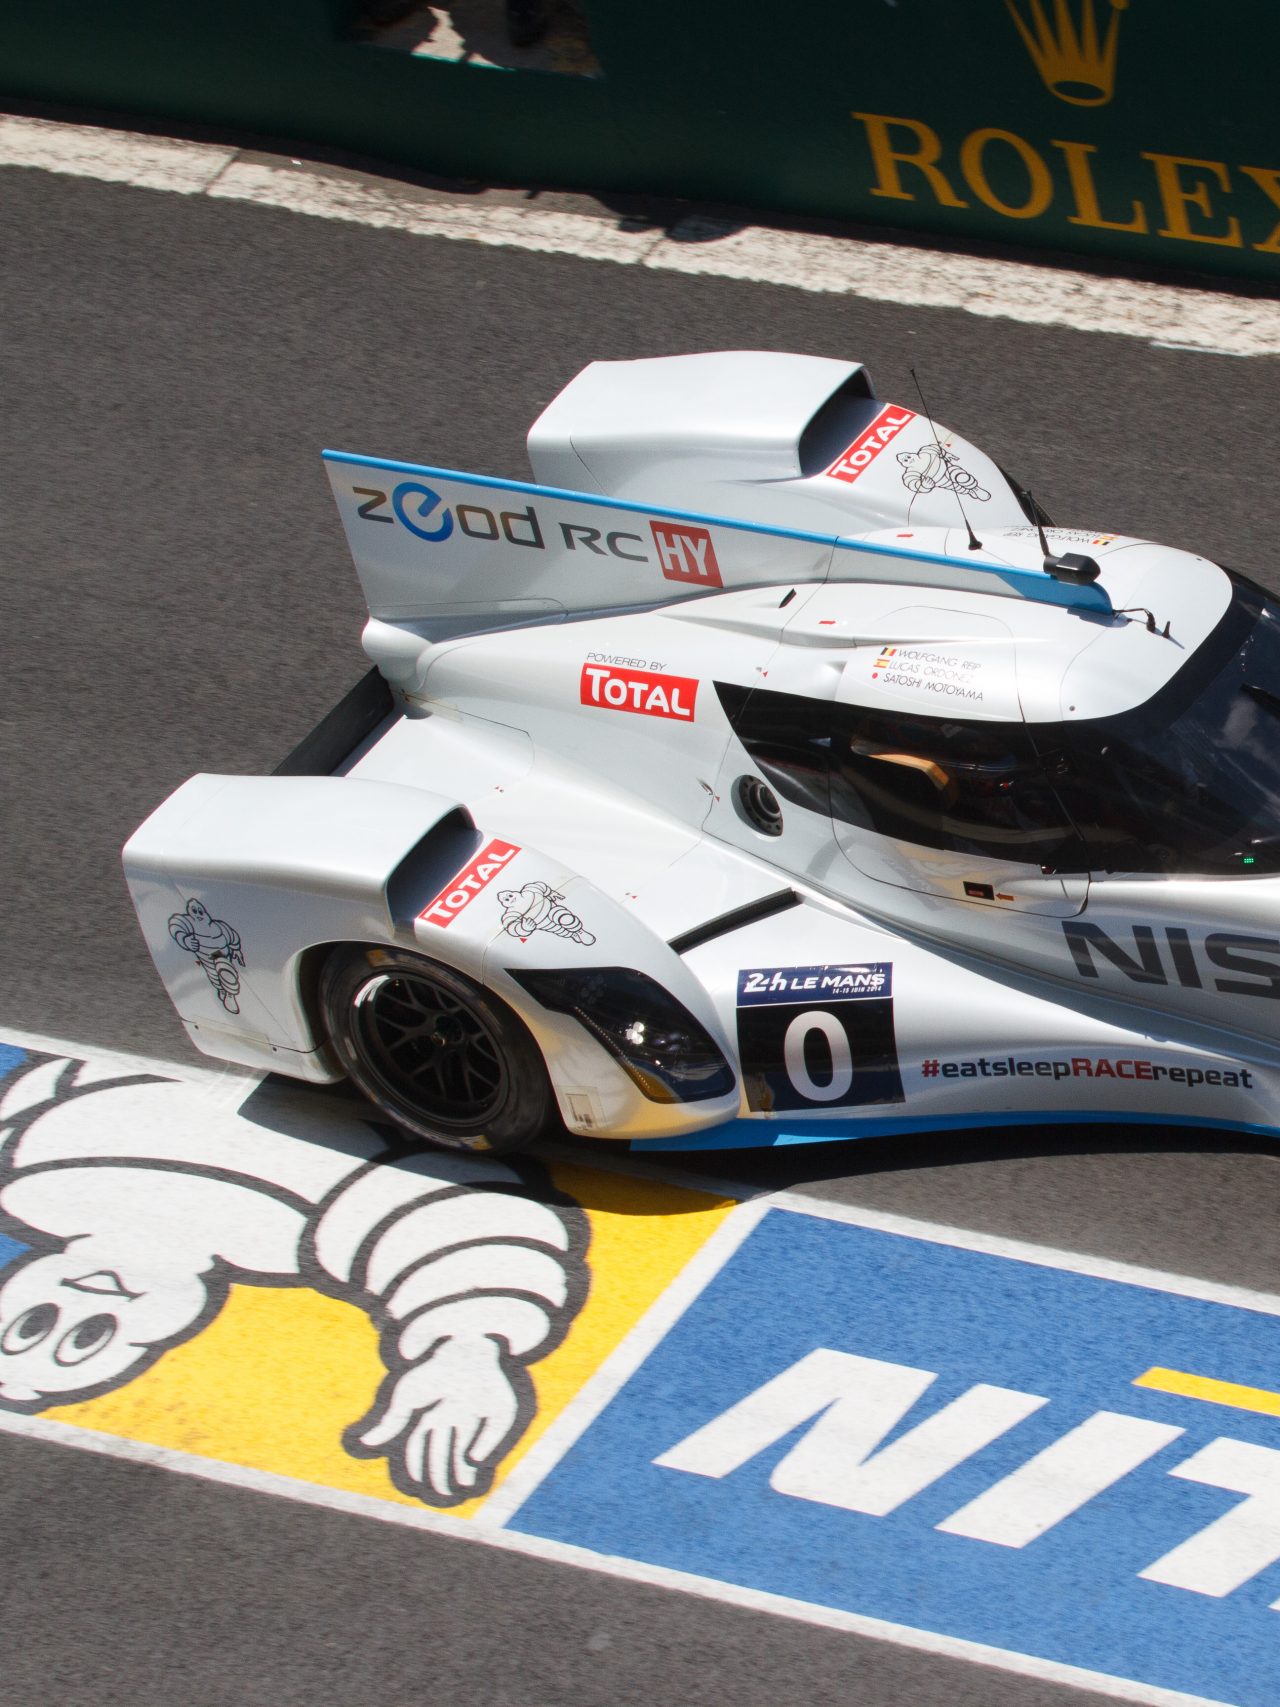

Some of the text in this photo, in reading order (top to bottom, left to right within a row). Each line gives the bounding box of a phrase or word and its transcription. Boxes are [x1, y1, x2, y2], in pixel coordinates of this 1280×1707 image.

[830, 413, 912, 476] TOTAL
[558, 522, 650, 563] RC
[655, 530, 709, 577] HY
[586, 651, 668, 672] POWERED BY
[888, 660, 920, 674] LUCAS
[898, 649, 959, 668] WOLFGANG
[585, 667, 691, 717] TOTAL
[883, 672, 985, 702] SATOSHI MOTOYAMA
[424, 848, 516, 920] TOTAL
[790, 976, 819, 991] LE
[820, 973, 886, 988] MANS
[783, 1010, 854, 1102] 0
[921, 1057, 1254, 1089] #eatsleepRACErepeat
